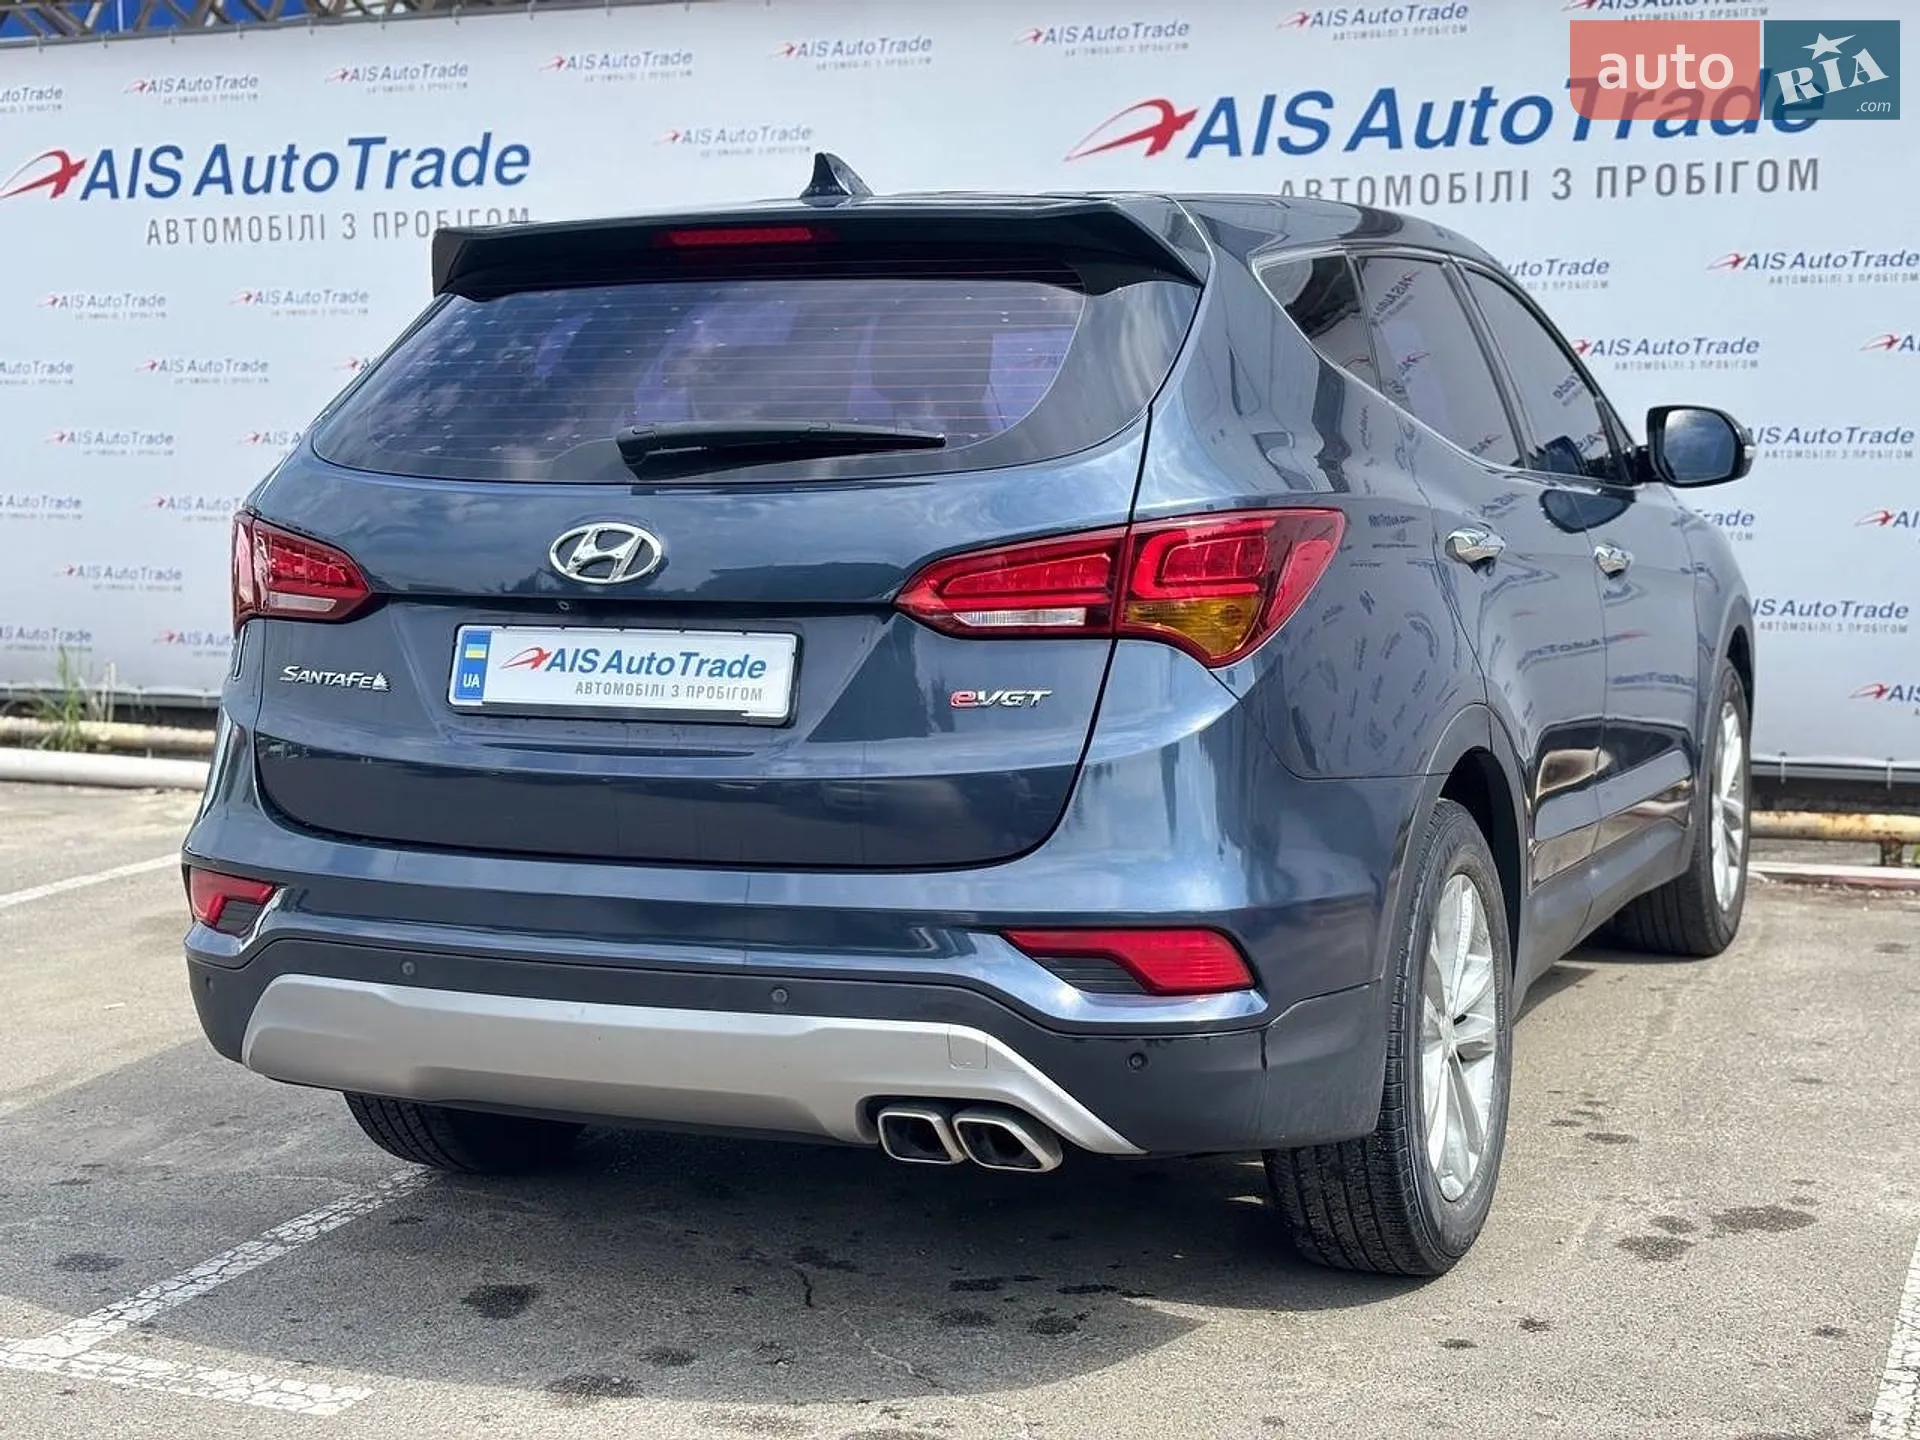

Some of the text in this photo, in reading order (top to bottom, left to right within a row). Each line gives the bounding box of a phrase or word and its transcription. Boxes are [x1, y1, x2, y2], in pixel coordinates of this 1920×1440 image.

[1310, 2, 1469, 28] AIS AutoTrade
[1043, 20, 1190, 45] AIS AutoTrade
[1185, 68, 1825, 159] AIS AutoTrade
[80, 131, 531, 200] AIS AutoTrade
[1281, 158, 1819, 206] АВТОМОБІЛІ З ПРОБІГОМ
[146, 207, 529, 246] АВТОМОБІЛІ З ПРОБІГОМ
[1743, 249, 1920, 270] AIS AutoTrade
[1590, 336, 1760, 357] AIS AutoTrade
[1783, 425, 1915, 445] AutoTrade
[1778, 598, 1910, 620] AutoTrade
[545, 647, 768, 680] AIS AutoTrade
[462, 672, 481, 689] UA
[575, 681, 666, 698] АВТОМОБІЛІ
[686, 684, 763, 702] ПРОБІГОМ
